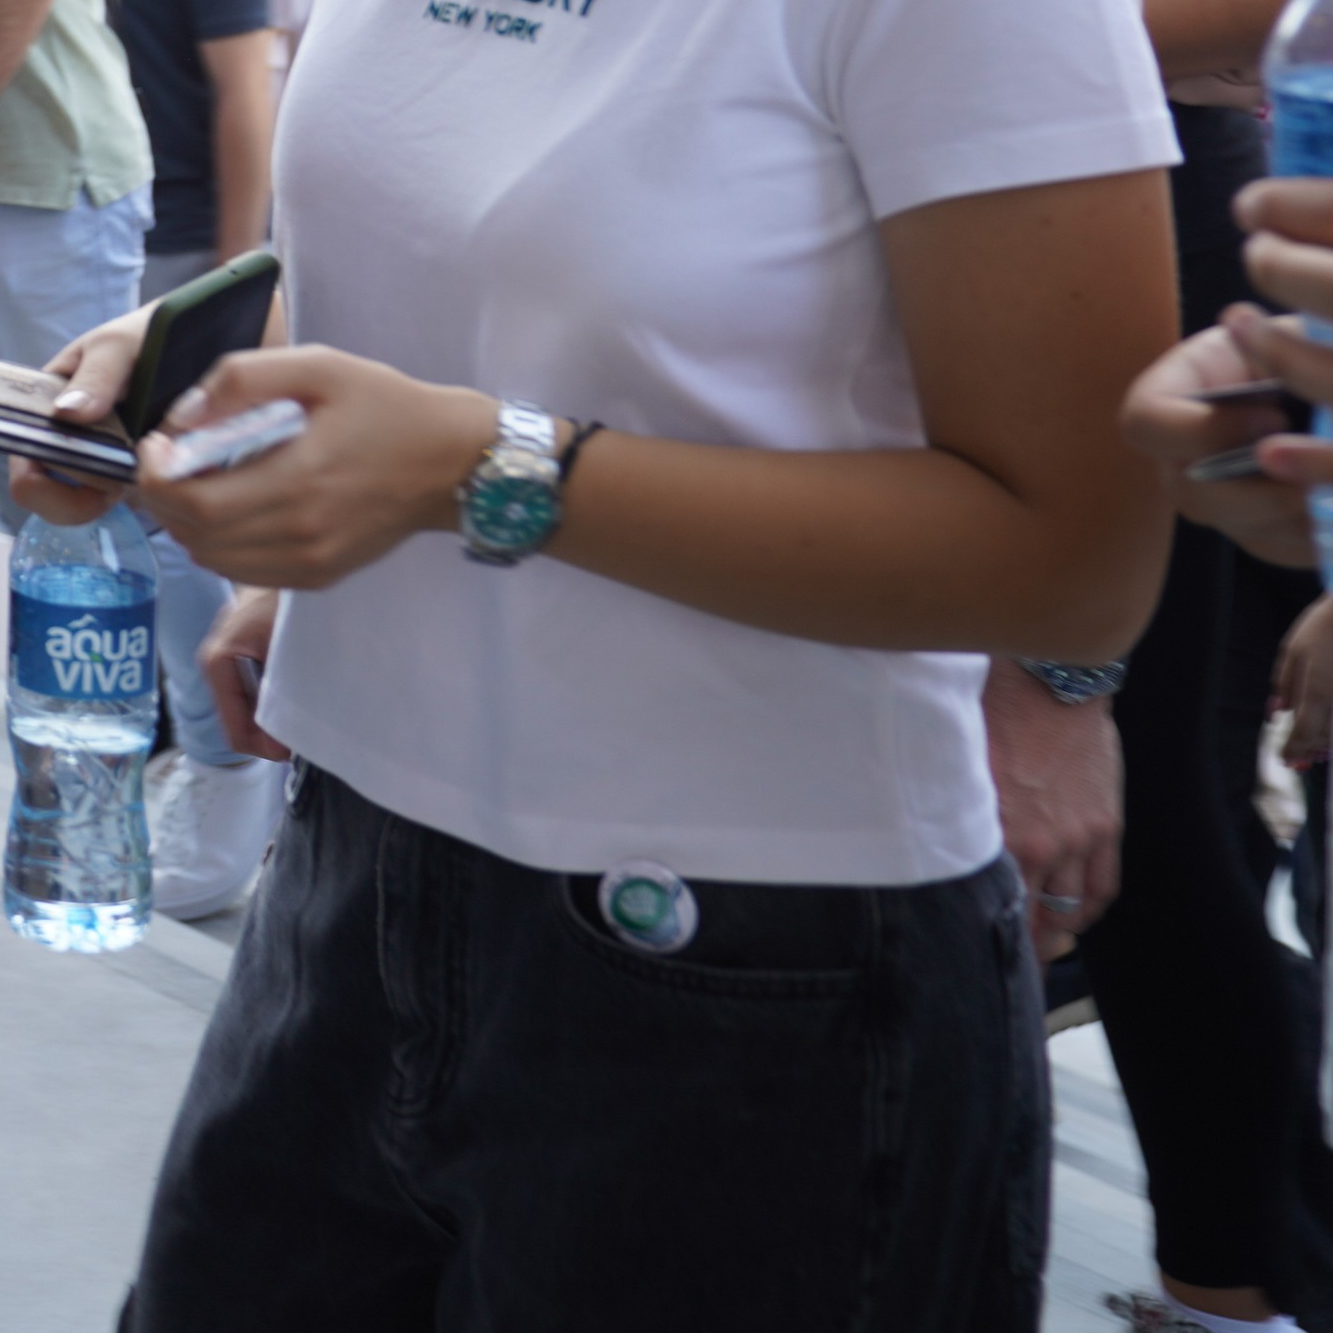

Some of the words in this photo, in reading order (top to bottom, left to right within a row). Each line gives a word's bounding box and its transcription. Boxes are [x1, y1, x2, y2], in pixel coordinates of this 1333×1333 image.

[483, 10, 543, 44] YORK
[45, 622, 149, 662] aqua
[52, 659, 143, 694] viva
